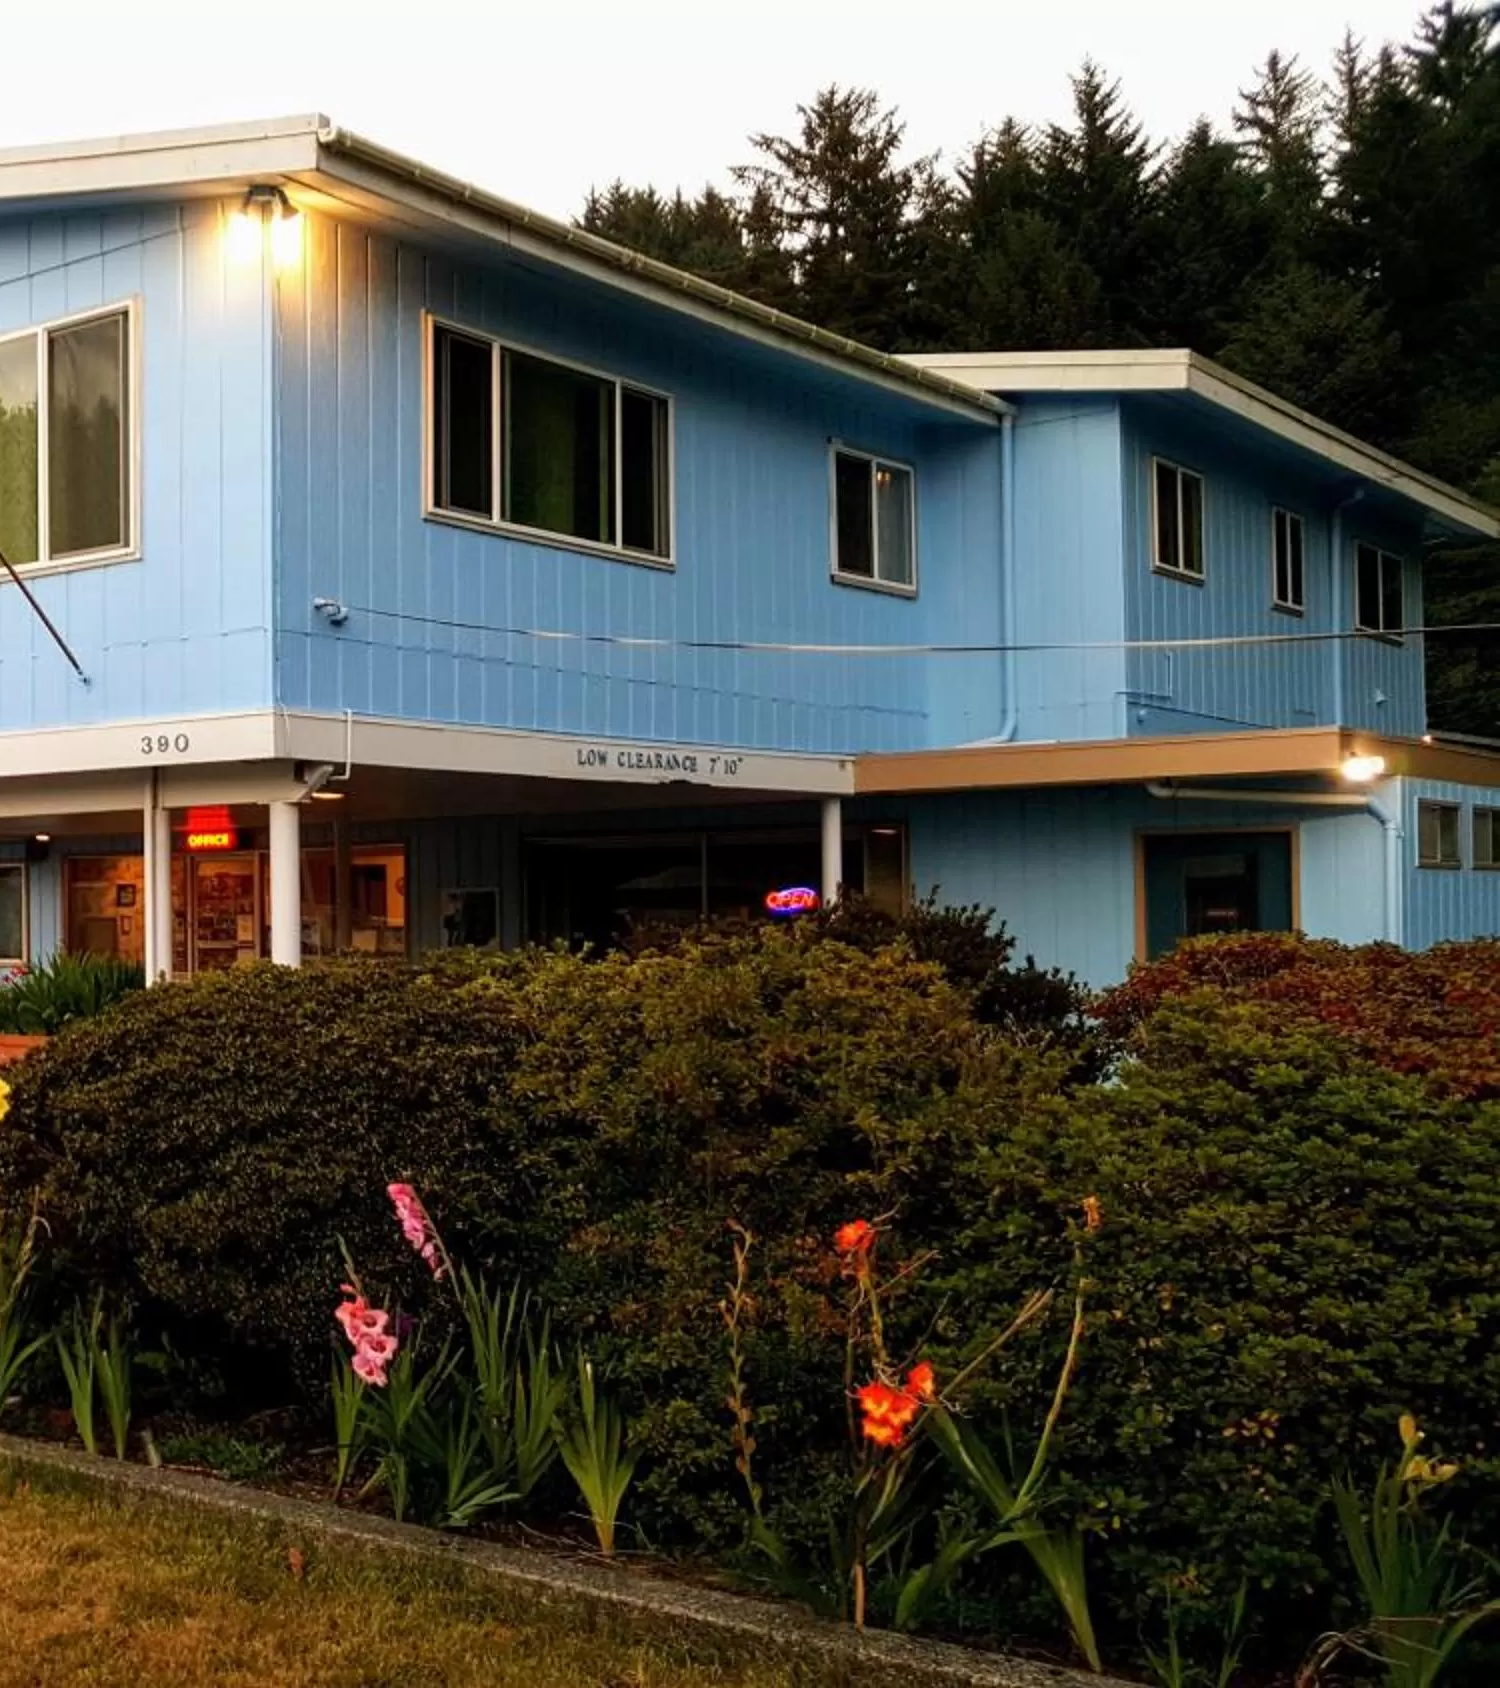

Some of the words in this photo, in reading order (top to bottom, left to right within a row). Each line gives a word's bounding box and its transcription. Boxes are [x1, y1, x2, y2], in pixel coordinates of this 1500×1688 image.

[141, 733, 189, 755] 390
[576, 749, 607, 768] LOW
[617, 751, 698, 773] CLEARANCE
[188, 833, 229, 848] OFFICE
[766, 891, 815, 909] OPEN
